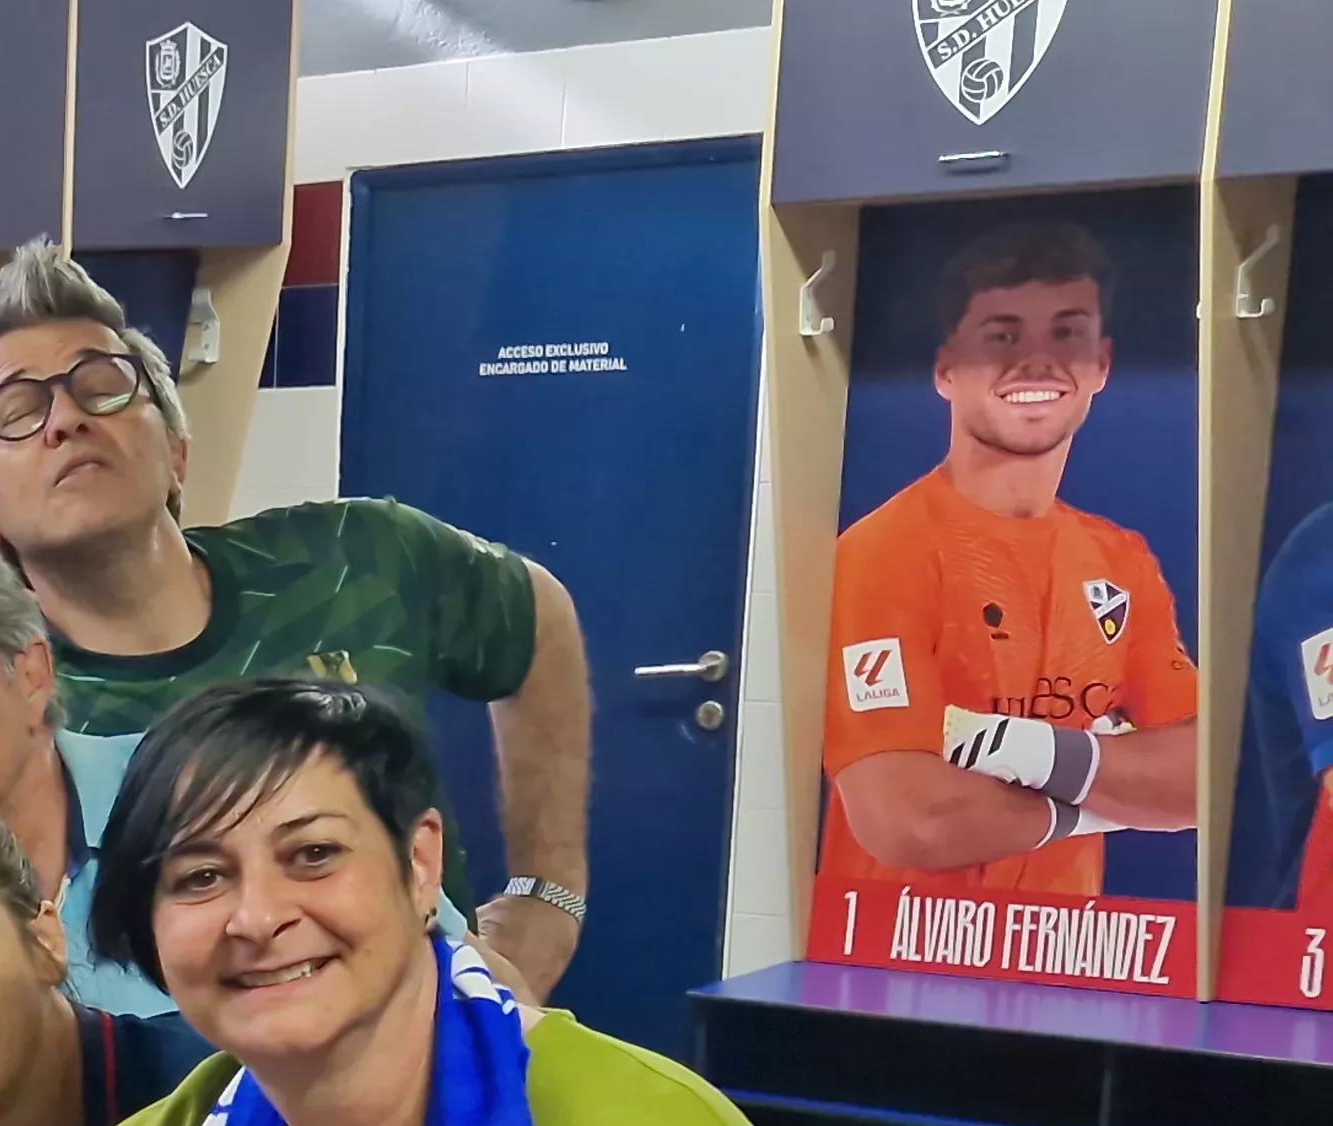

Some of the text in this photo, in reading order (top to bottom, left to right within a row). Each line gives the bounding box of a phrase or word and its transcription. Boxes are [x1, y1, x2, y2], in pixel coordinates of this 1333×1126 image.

[937, 29, 977, 61] S.D.
[497, 342, 609, 359] ACCESO EXCLUSIVO
[479, 357, 627, 376] ENCARGADO DE MATERIAL
[856, 688, 900, 702] LALIGA
[844, 886, 1176, 985] 1 ÁLVARO FERNÁNDEZ
[1300, 928, 1326, 998] 3
